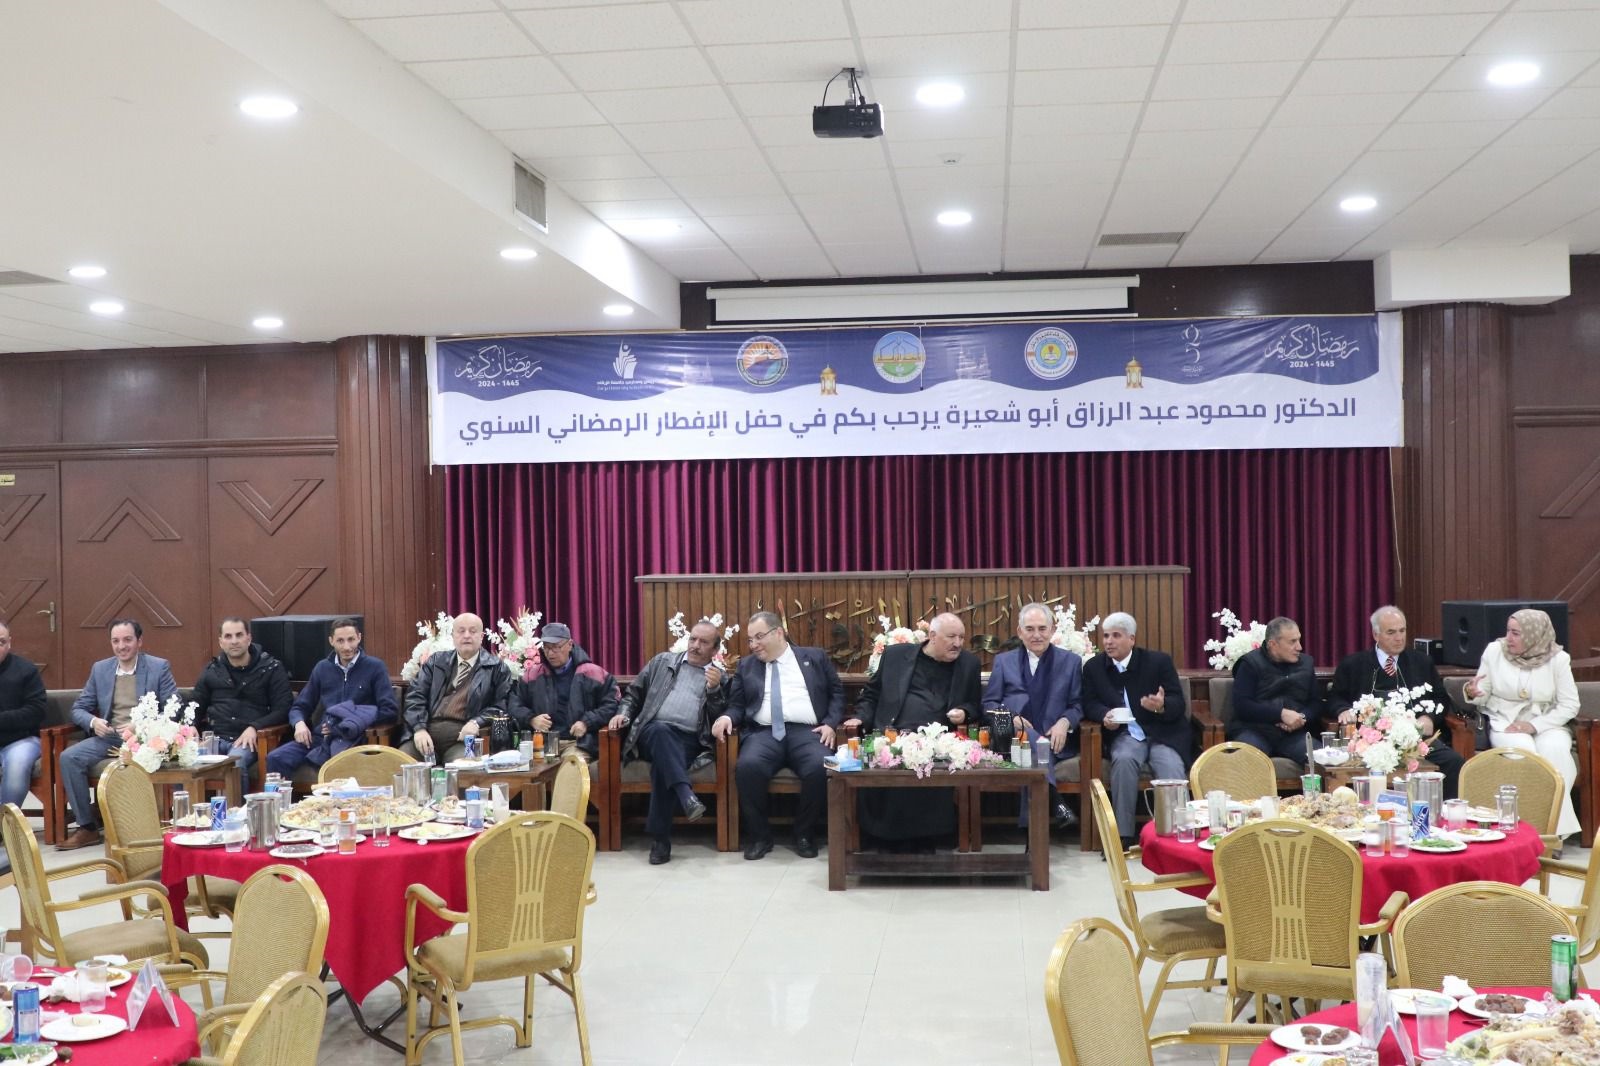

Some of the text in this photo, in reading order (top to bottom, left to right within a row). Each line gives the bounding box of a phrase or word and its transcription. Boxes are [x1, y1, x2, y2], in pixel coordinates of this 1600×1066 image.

[1290, 360, 1309, 368] 2024
[1315, 360, 1335, 368] 1445
[502, 379, 519, 387] 1445
[458, 397, 1356, 447] الدكتور محمود عبد الرزاق أبو شعيرة يرحب بكم في حفل الإفطار الرمضاني السنوي
